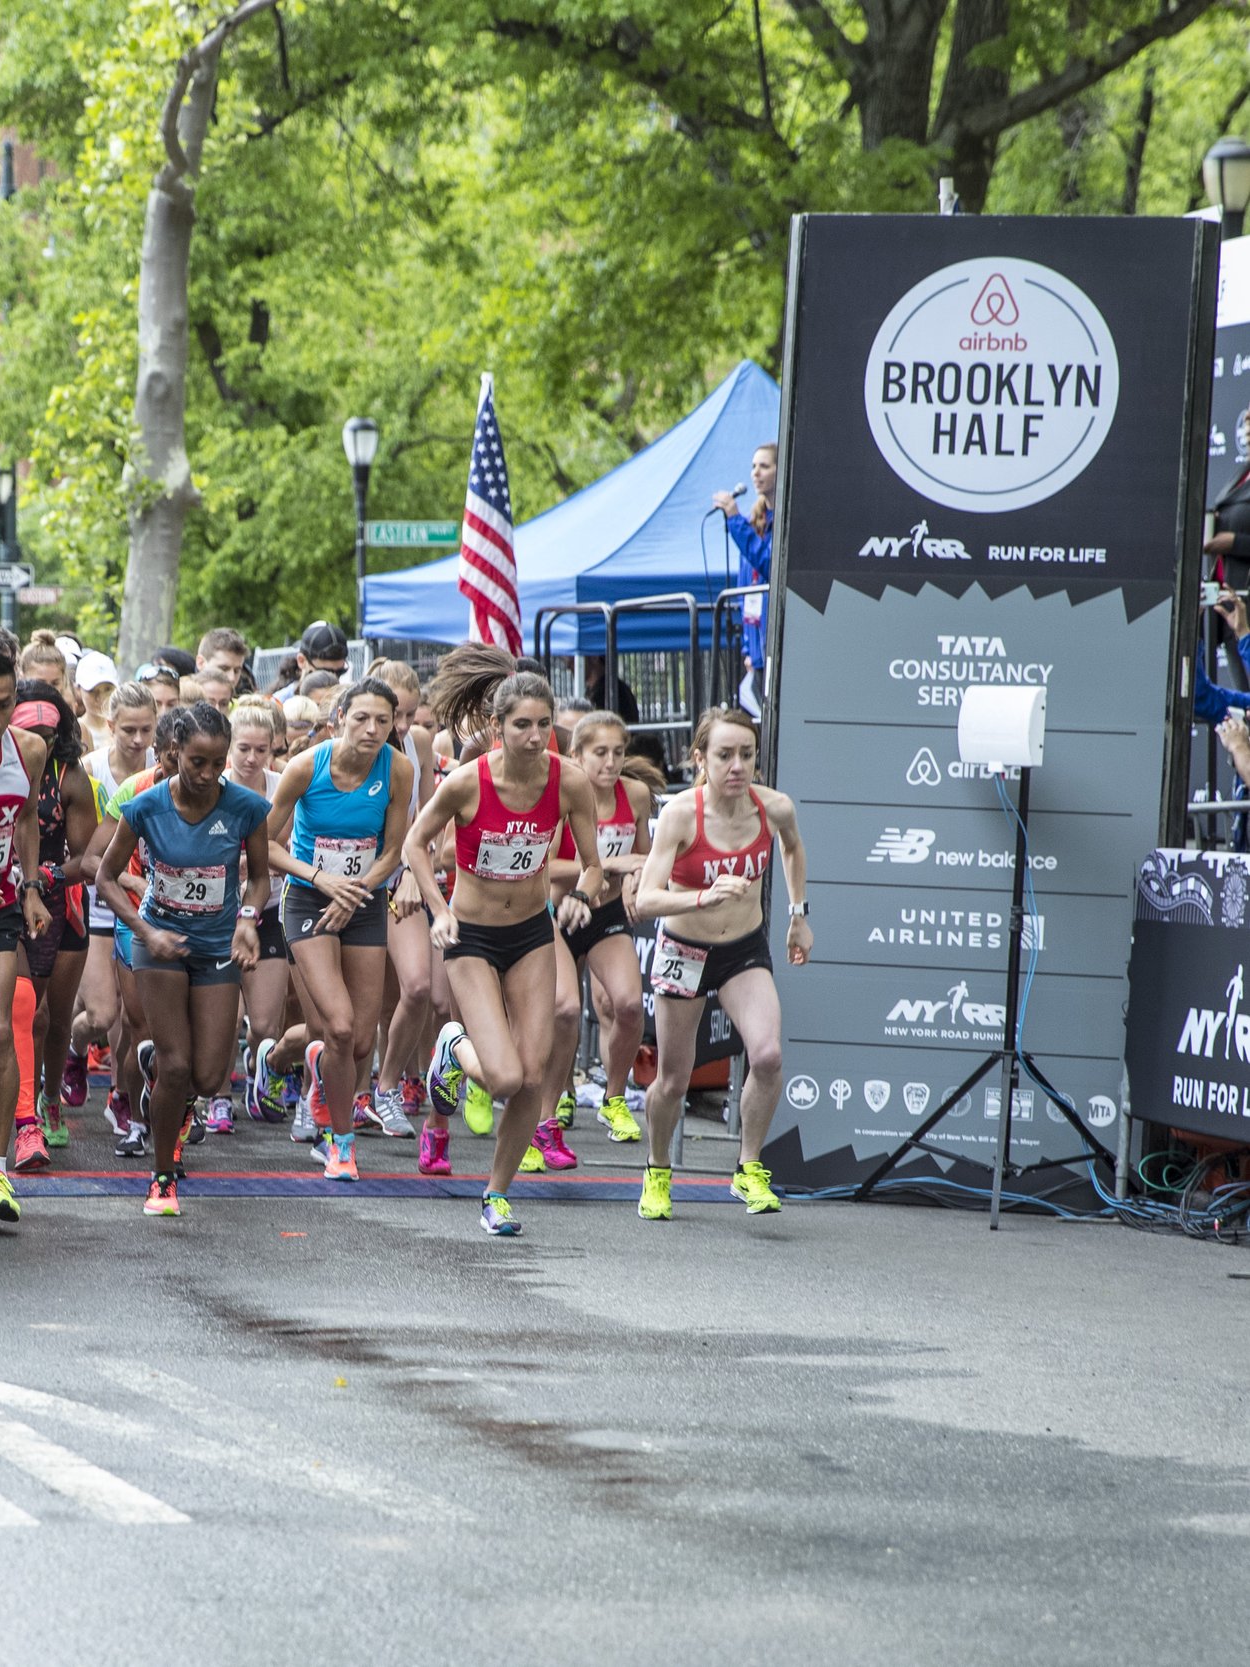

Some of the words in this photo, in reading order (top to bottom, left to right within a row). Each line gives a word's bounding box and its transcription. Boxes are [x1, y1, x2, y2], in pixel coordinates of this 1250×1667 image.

[959, 332, 1027, 351] airbnb
[881, 361, 1102, 408] BROOKLYN
[932, 412, 1044, 456] HALF
[988, 545, 1025, 561] RUN
[1029, 547, 1066, 562] FOR
[1069, 548, 1107, 563] LIFE
[937, 635, 1007, 657] TATA
[889, 659, 1053, 684] CONSULTANCY
[506, 821, 537, 834] NYAC
[606, 842, 622, 858] 27
[936, 850, 974, 866] new
[344, 855, 362, 876] 35
[510, 851, 532, 870] 26
[184, 882, 207, 901] 29
[901, 909, 1002, 928] UNITED
[868, 927, 1001, 948] AIRLINES
[662, 959, 684, 980] 25
[884, 1026, 908, 1036] NEW
[910, 1027, 938, 1038] YORK
[941, 1029, 970, 1040] ROAD
[1173, 1075, 1204, 1109] RUN
[1207, 1081, 1239, 1115] FOR
[1089, 1103, 1111, 1119] MTA
